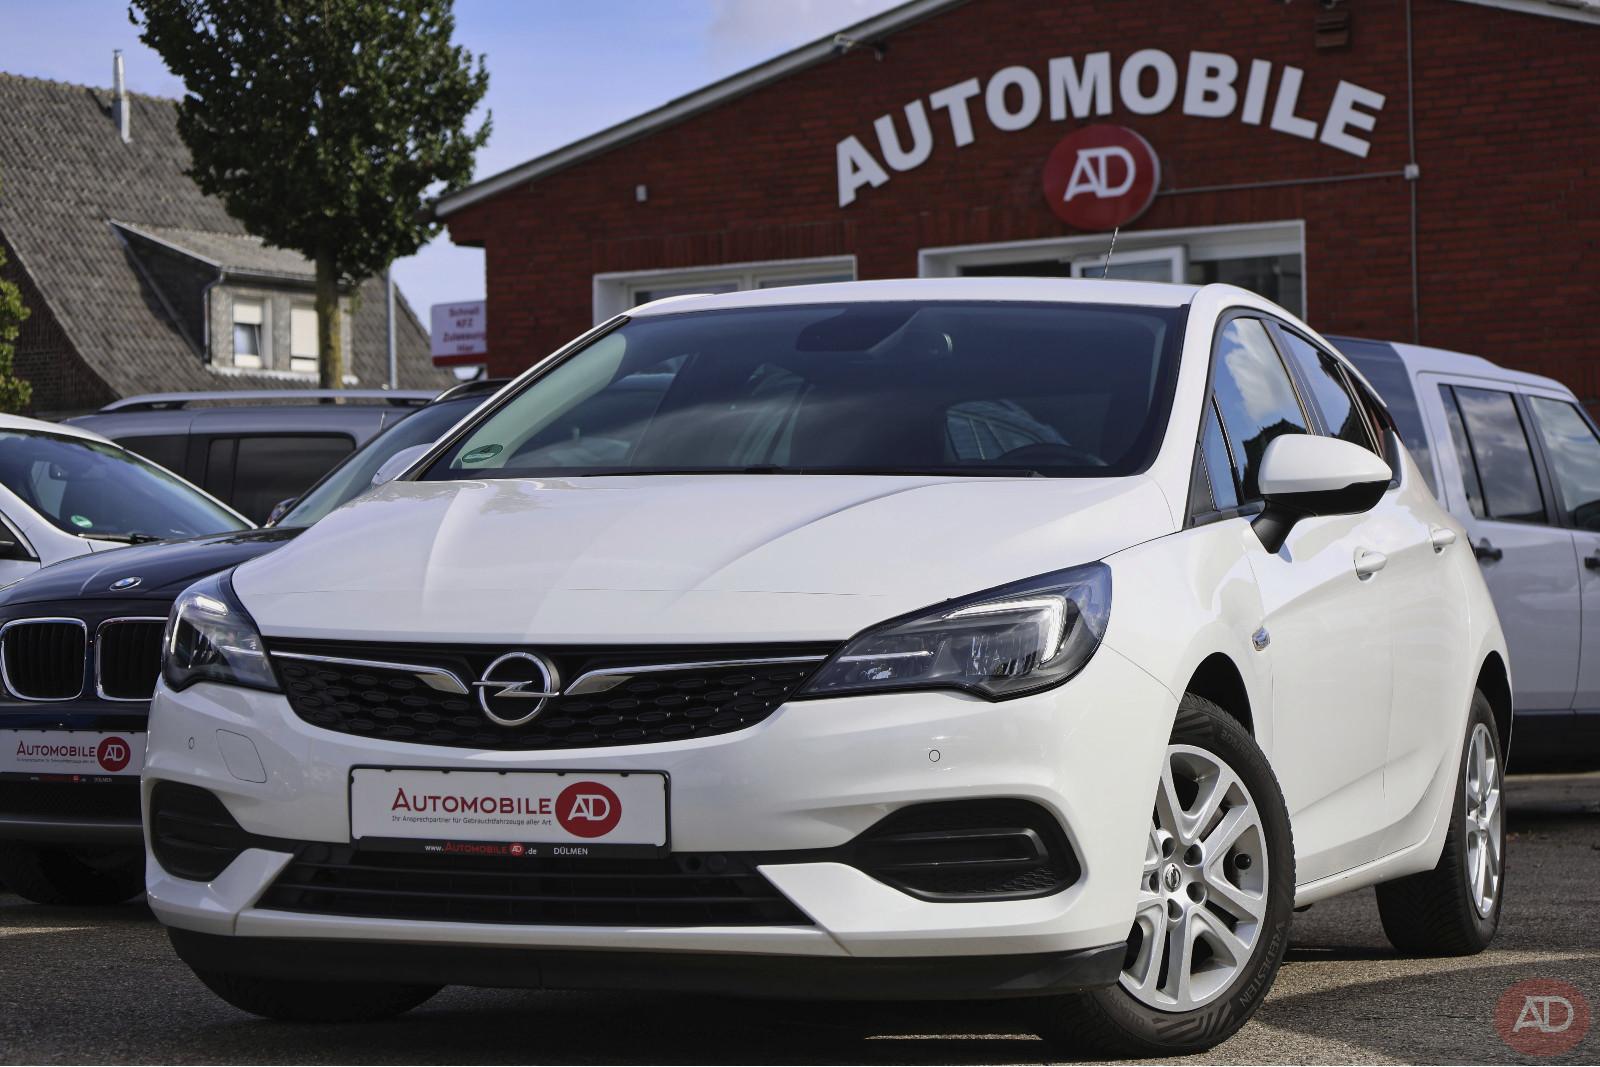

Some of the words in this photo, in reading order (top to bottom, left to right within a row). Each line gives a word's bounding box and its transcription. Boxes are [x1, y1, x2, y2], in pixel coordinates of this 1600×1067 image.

[836, 49, 1386, 207] AUTOMOBILE
[1064, 146, 1137, 201] AD
[103, 744, 125, 761] AD
[567, 794, 611, 821] AD
[402, 815, 450, 823] Ansprechpartner
[452, 816, 462, 824] für
[462, 817, 525, 826] Gebrauchtfahrzeuge
[553, 846, 588, 855] DÜLMEN
